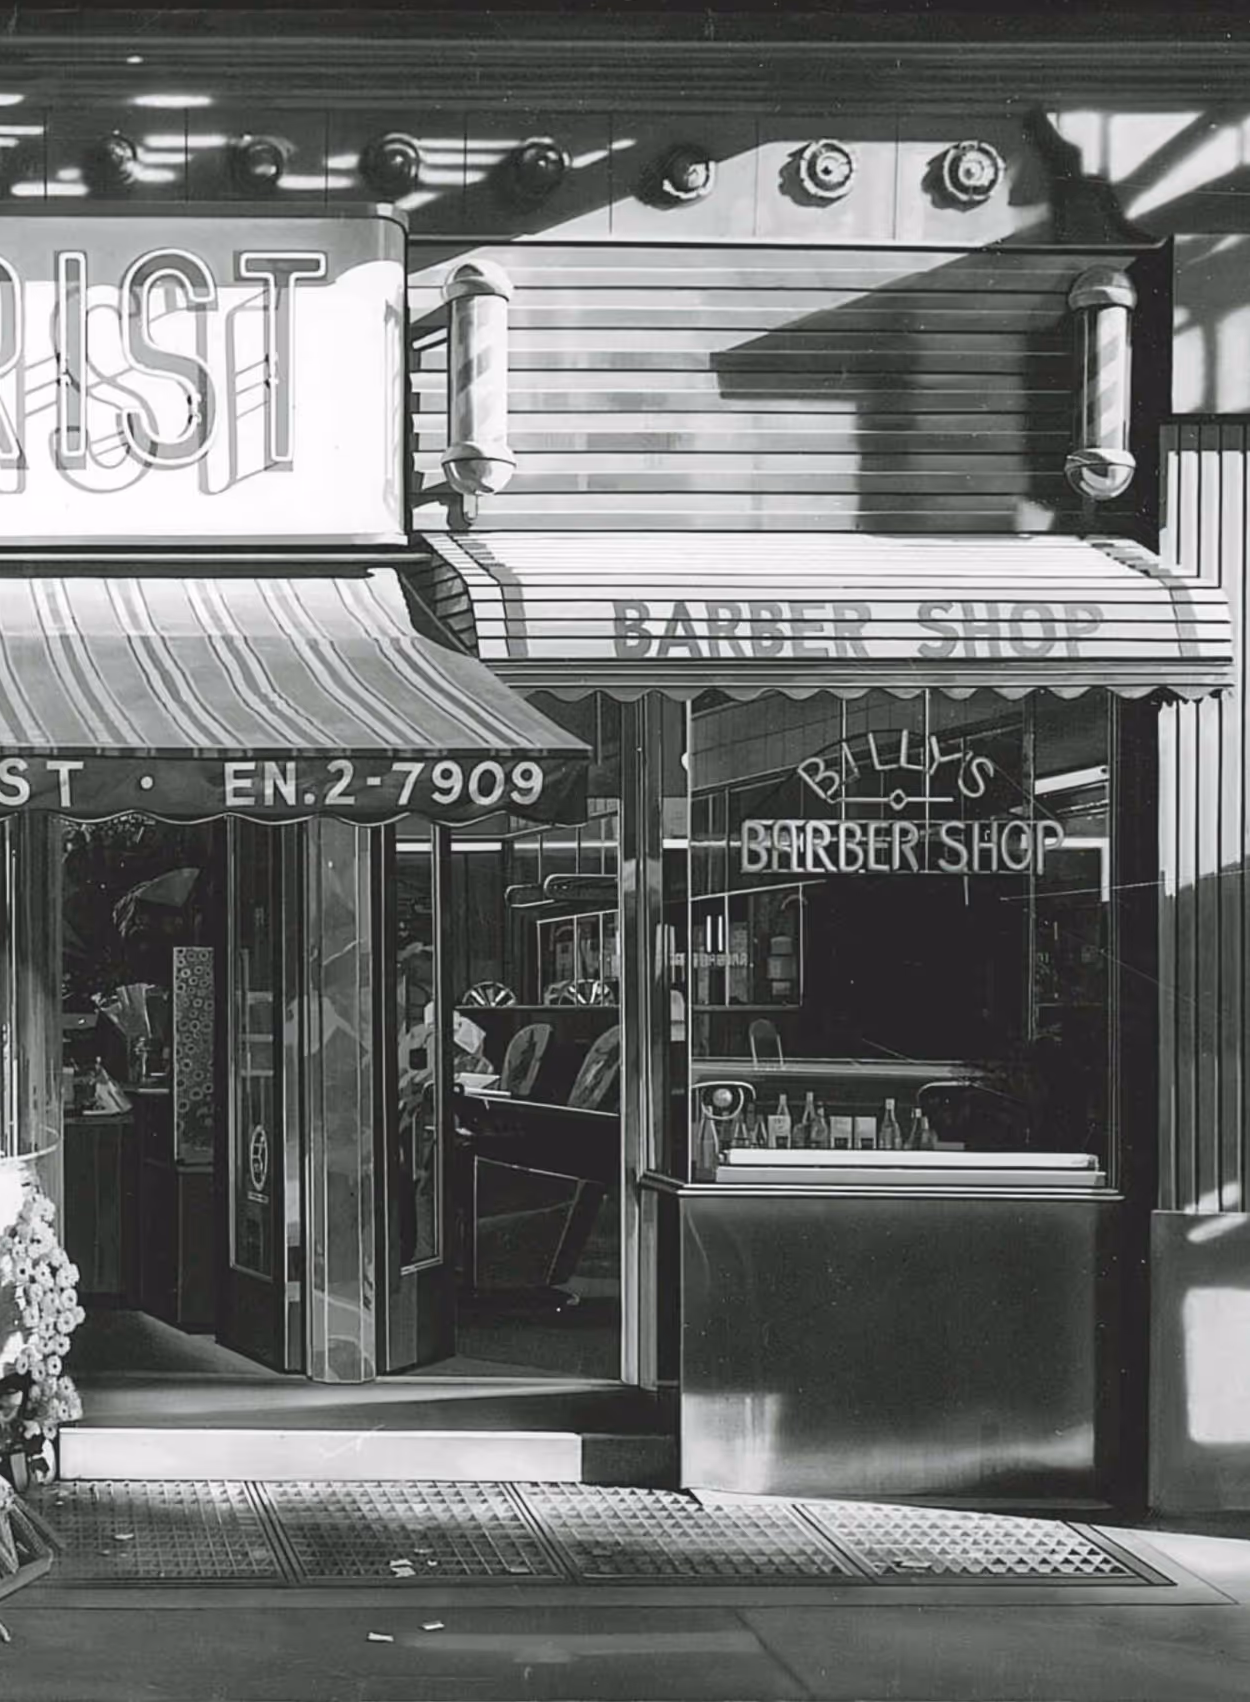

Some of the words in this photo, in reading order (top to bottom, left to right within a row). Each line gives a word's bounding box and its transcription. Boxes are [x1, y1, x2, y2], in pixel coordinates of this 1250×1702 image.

[611, 601, 872, 659] BARBER
[916, 602, 1105, 659] SHOP
[741, 820, 920, 874] BARBER
[937, 820, 1065, 876] SHOP
